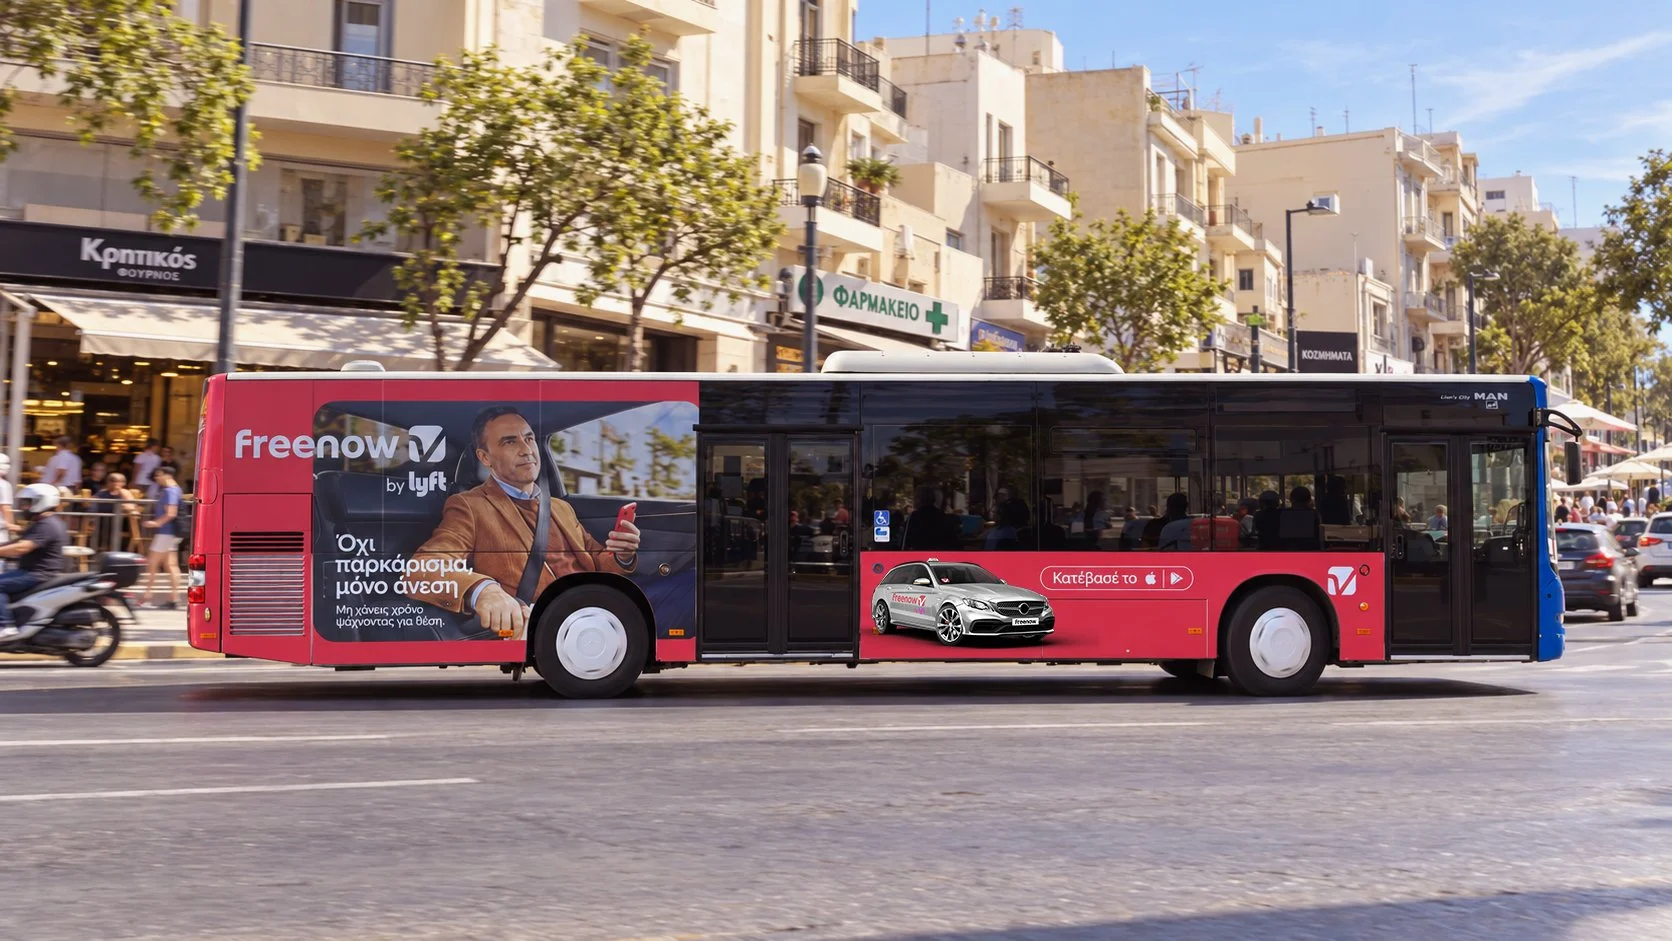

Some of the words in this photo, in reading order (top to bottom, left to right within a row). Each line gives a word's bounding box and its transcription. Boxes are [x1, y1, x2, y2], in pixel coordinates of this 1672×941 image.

[80, 237, 197, 270] Κρητικός
[117, 267, 180, 281] ΦΟΥΡΝΟΣ
[833, 284, 920, 321] ΦΑΡΜΑΚΕΙΟ
[1474, 392, 1508, 400] MAN
[235, 429, 400, 459] freenow
[386, 477, 405, 495] by
[408, 471, 446, 497] lyft
[335, 533, 376, 556] Όχι
[335, 554, 473, 577] παρκάρισμα,
[336, 576, 389, 599] μόνο
[393, 575, 458, 599] άνεση
[1053, 571, 1119, 587] Κατέβασέ
[1122, 573, 1137, 584] το
[336, 605, 353, 616] Μη
[355, 604, 389, 616] χάνεις
[391, 604, 424, 616] χρόνο
[336, 616, 394, 629] ψάχνοντας
[396, 618, 413, 628] για
[415, 616, 445, 628] θέση.
